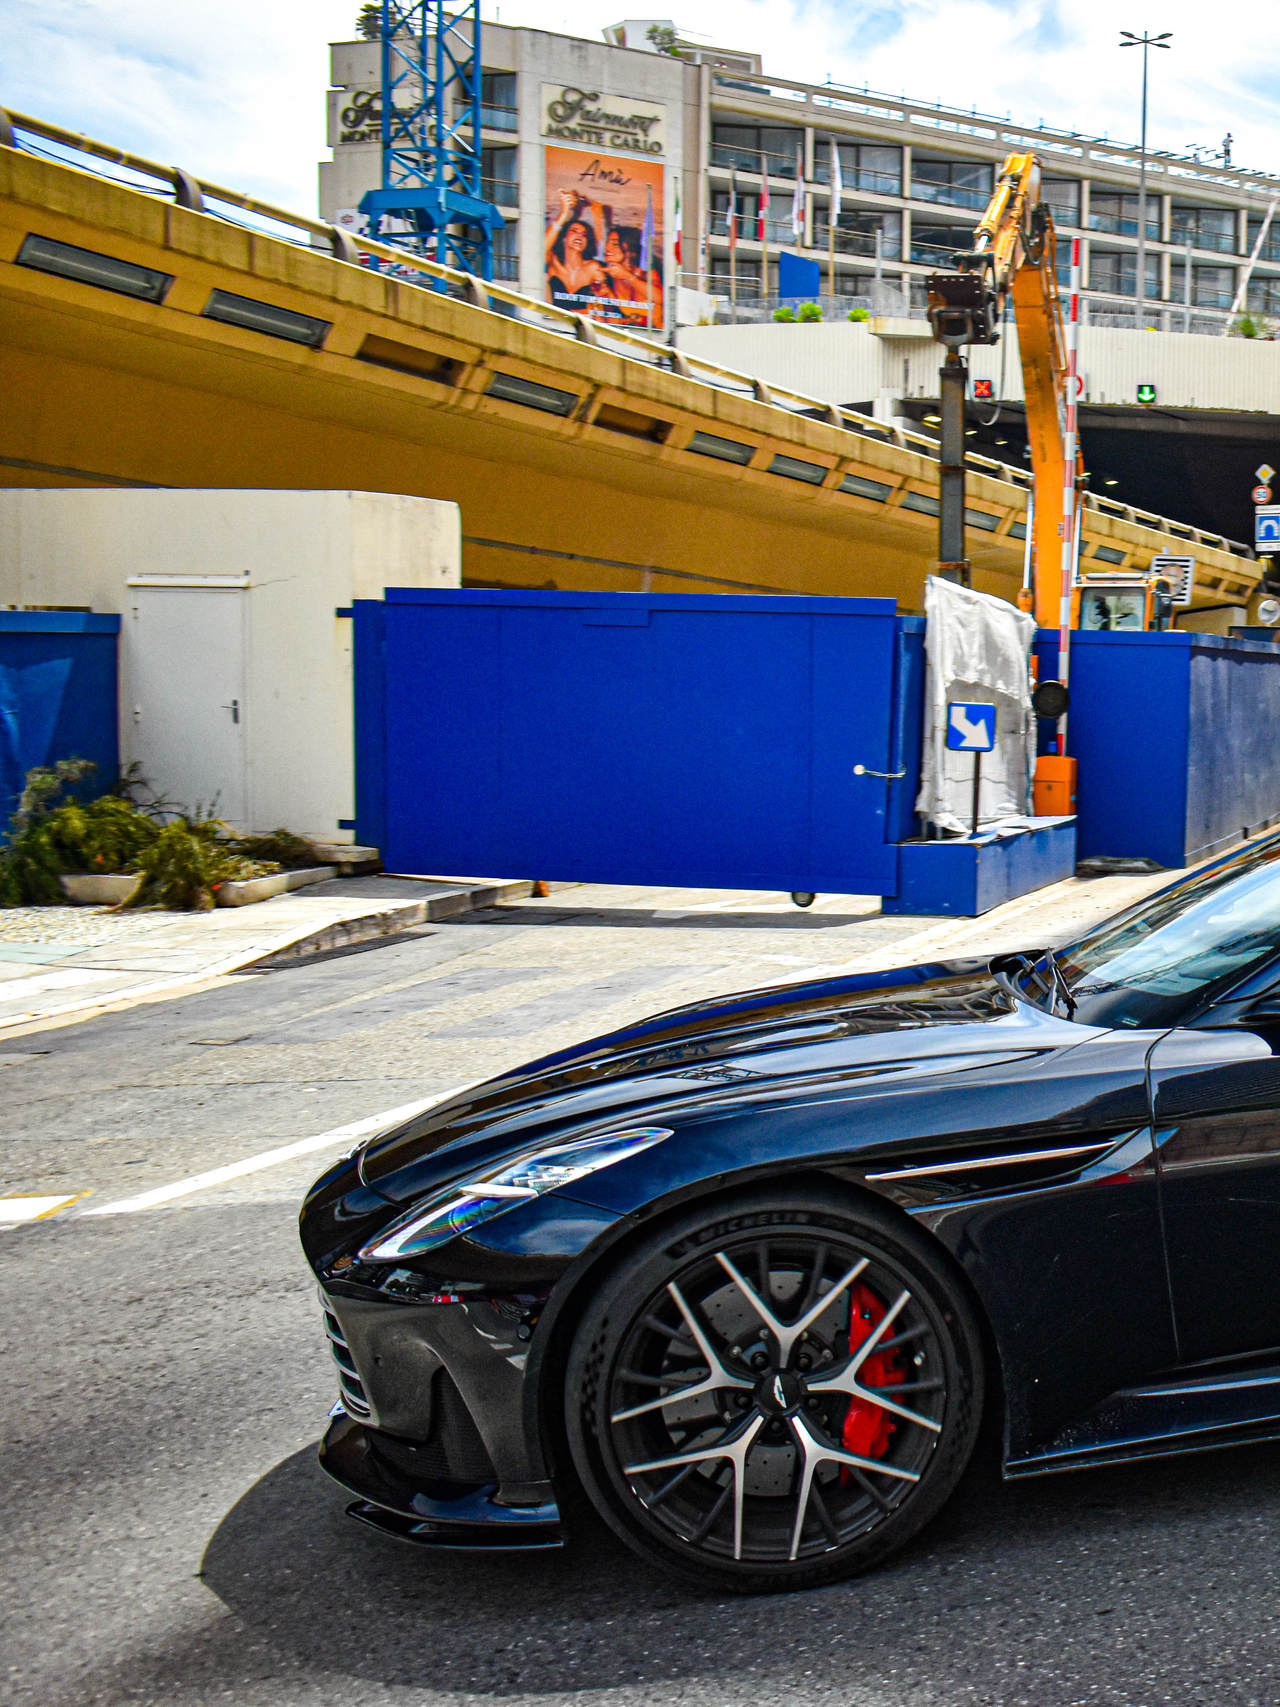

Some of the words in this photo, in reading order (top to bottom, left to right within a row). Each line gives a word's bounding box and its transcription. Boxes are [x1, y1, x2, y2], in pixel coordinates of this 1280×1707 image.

[547, 87, 662, 137] Fairmont
[546, 123, 605, 144] MONTE
[609, 134, 662, 153] CARLO
[699, 1213, 810, 1242] MICHELIN
